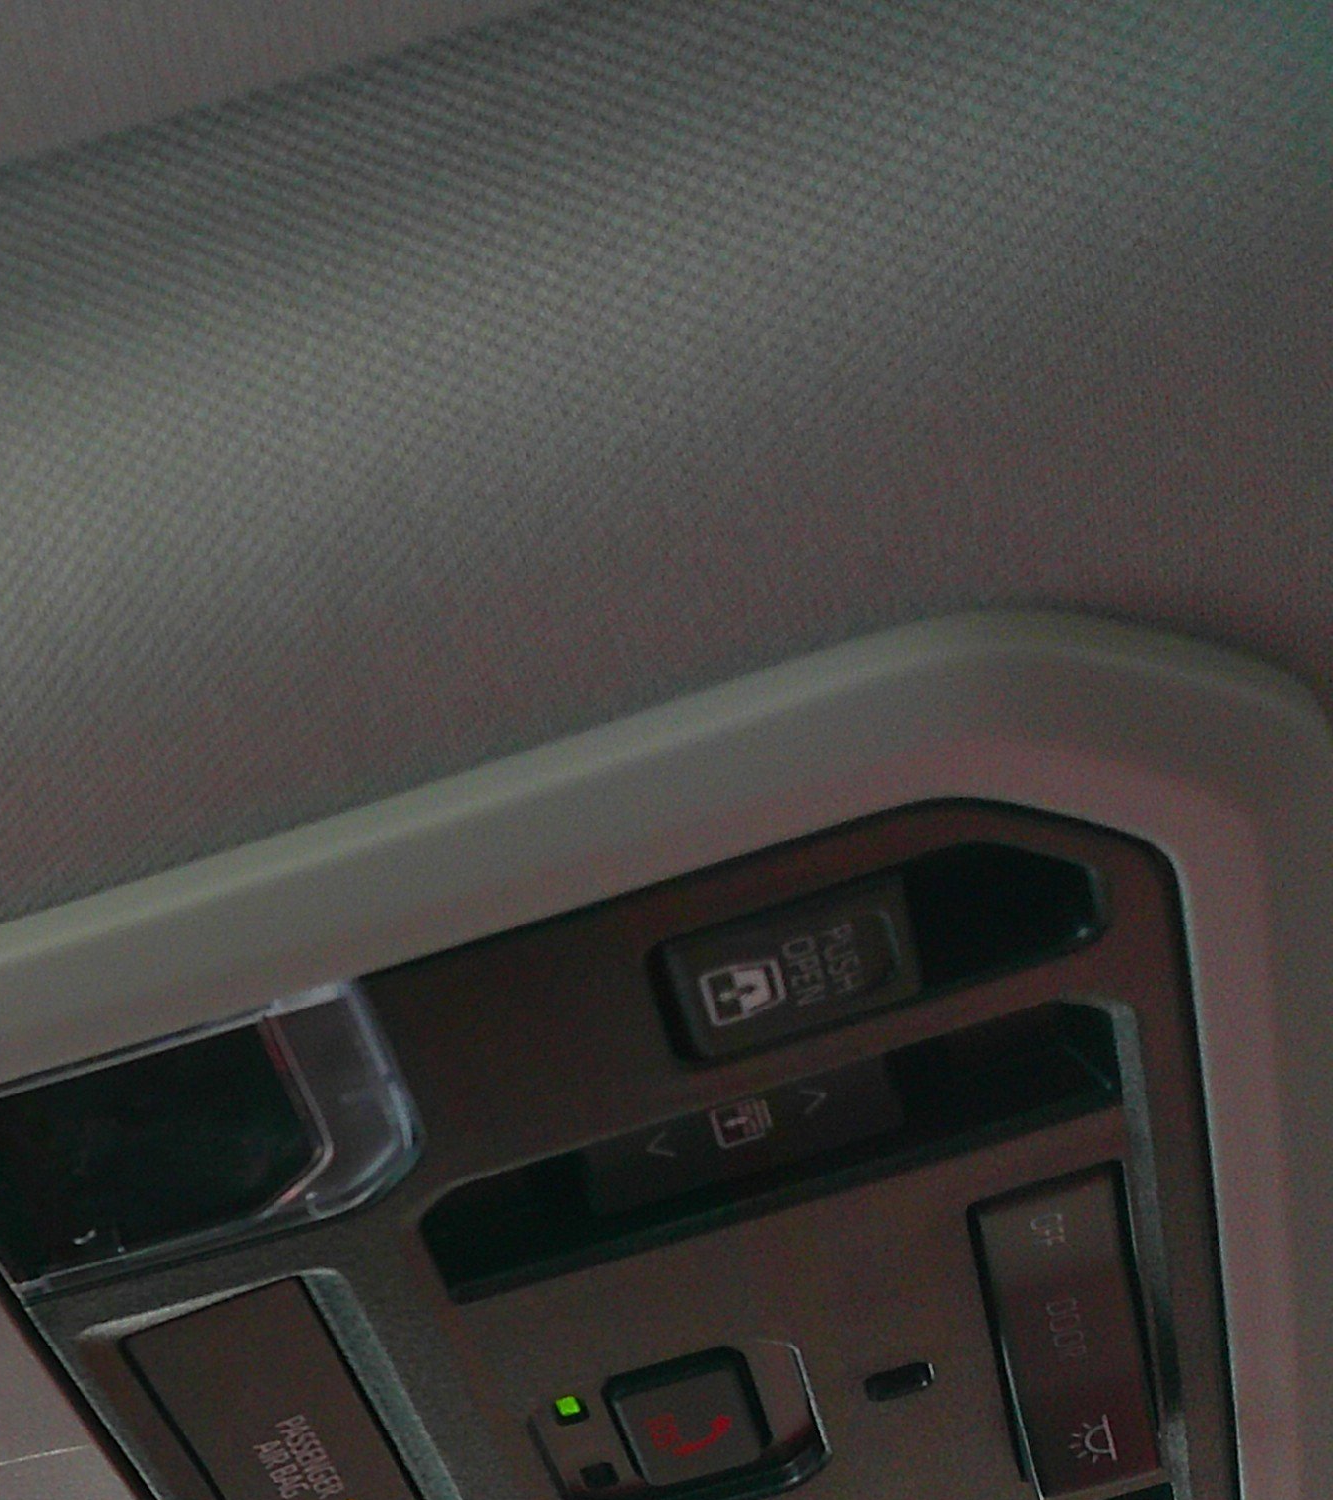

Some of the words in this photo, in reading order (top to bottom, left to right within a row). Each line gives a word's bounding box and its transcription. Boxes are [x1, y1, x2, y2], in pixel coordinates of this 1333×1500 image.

[782, 936, 826, 1006] OPEN
[253, 1440, 291, 1470] AIR
[275, 1414, 345, 1500] PASSENGER
[269, 1464, 310, 1500] BAG
